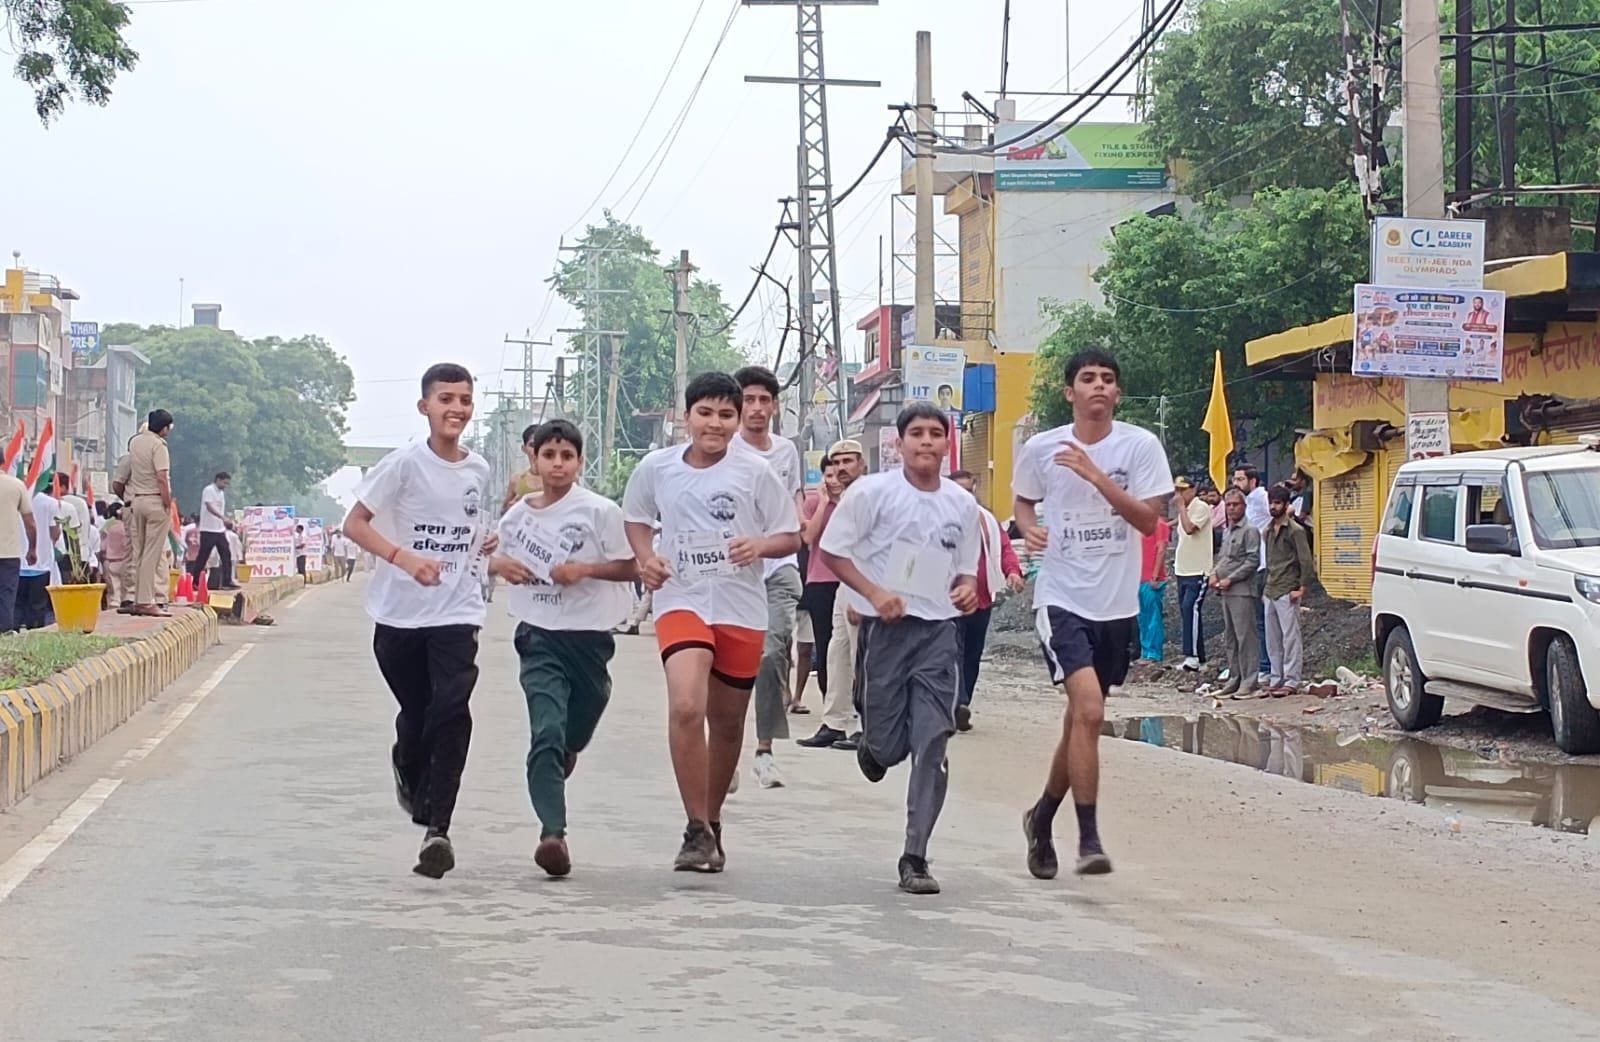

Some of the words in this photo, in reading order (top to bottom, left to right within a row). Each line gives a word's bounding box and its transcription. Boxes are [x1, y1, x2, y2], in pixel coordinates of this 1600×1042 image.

[1438, 231, 1473, 240] CAREER
[1438, 241, 1472, 249] ACADEMY
[1387, 256, 1411, 264] NEET
[1403, 265, 1457, 275] OLYMPIADS
[912, 386, 929, 396] IIT
[414, 524, 446, 535] नशा
[413, 537, 469, 552] हरियाणा
[525, 540, 553, 563] 10558
[691, 551, 725, 565] 10554
[253, 564, 285, 576] No.1
